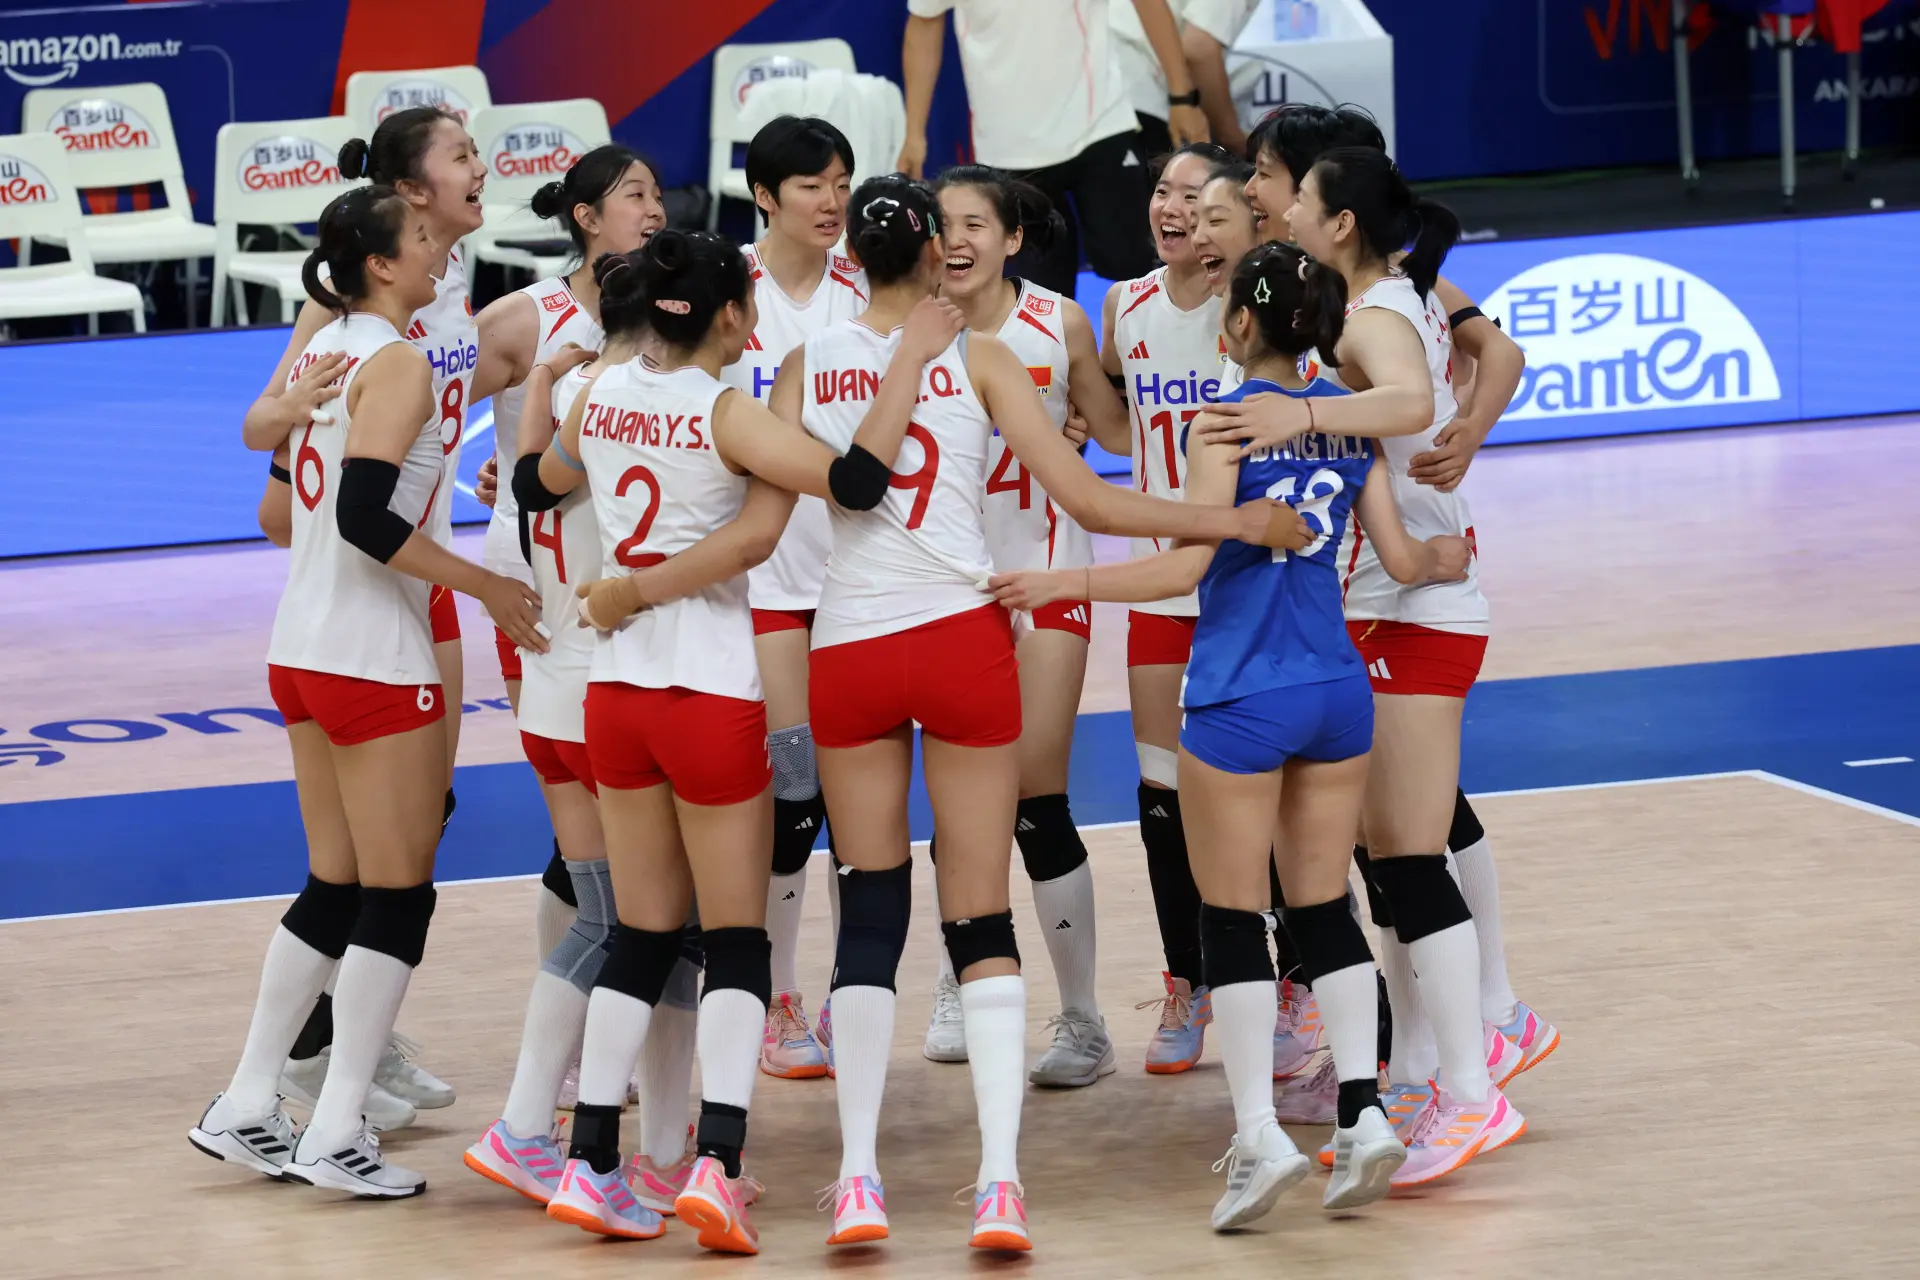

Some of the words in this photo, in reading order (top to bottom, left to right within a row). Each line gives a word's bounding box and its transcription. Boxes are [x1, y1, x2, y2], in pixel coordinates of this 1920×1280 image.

[64, 106, 124, 126] 百岁山
[254, 144, 314, 165] 百岁山
[1027, 295, 1053, 313] 光明
[1507, 277, 1685, 338] 百岁山
[427, 338, 479, 378] Haie
[814, 369, 880, 405] WAN
[1136, 370, 1220, 405] Haie
[296, 420, 324, 512] 6
[889, 421, 939, 530] 9
[986, 445, 1030, 510] 4
[614, 465, 667, 569] 2
[417, 684, 434, 712] 6
